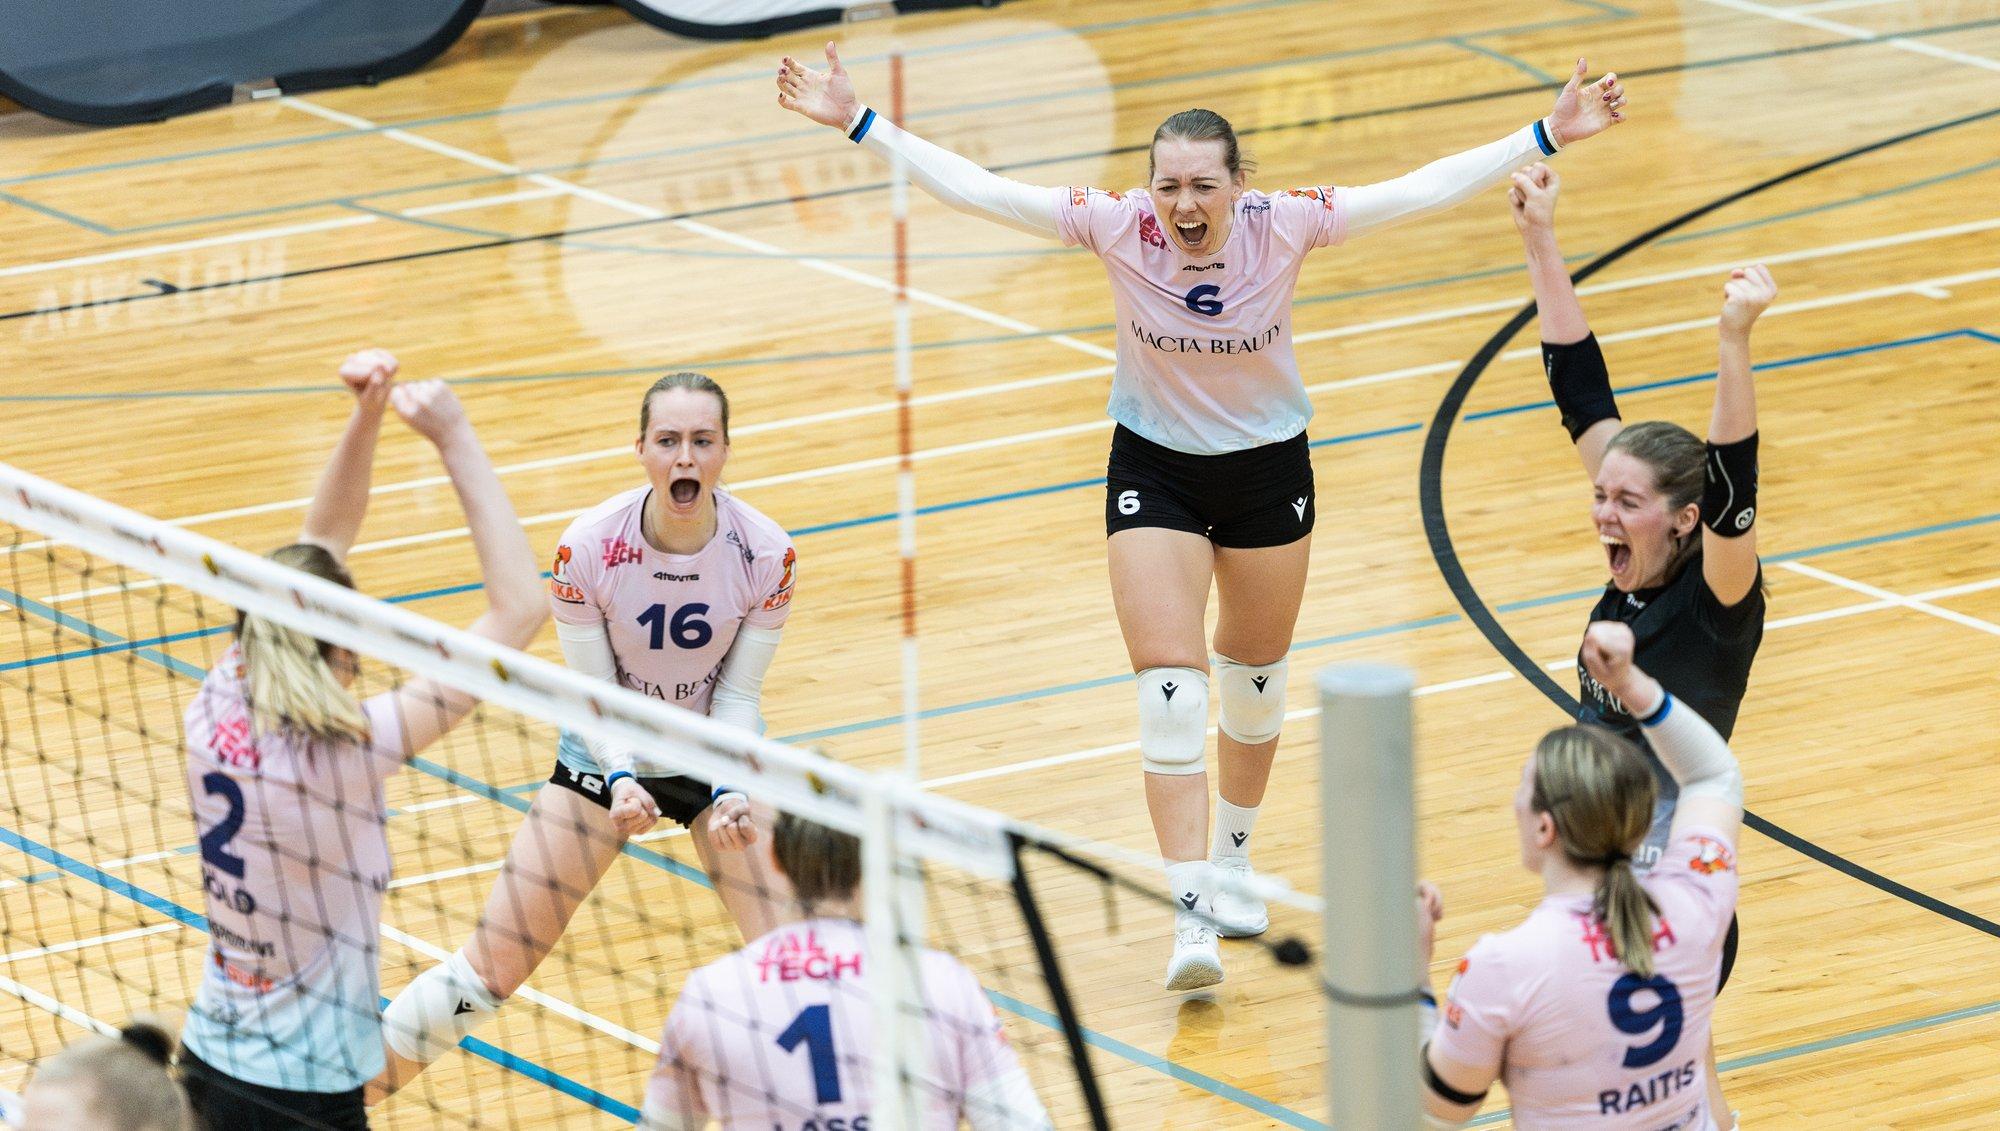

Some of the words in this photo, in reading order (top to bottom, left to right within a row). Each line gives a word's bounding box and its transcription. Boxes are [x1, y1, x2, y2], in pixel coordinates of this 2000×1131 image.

[1185, 284, 1225, 316] 6
[1131, 320, 1202, 353] MACTA
[1211, 318, 1282, 355] BEAUTY
[1118, 490, 1141, 515] 6
[636, 603, 713, 650] 16
[201, 771, 246, 879] 2
[757, 953, 862, 982] TECH
[1607, 972, 1684, 1070] 9
[776, 1005, 842, 1105] 1
[1599, 1060, 1696, 1116] RAITIS
